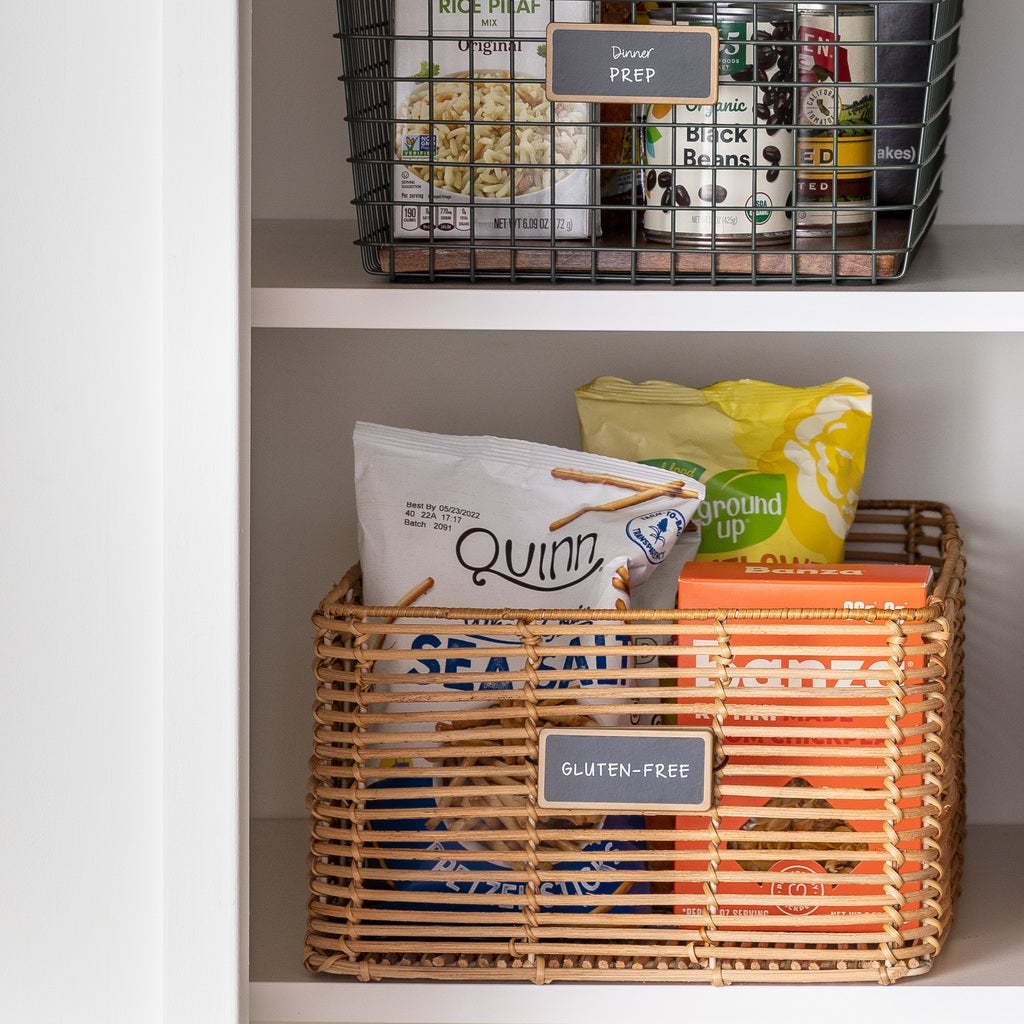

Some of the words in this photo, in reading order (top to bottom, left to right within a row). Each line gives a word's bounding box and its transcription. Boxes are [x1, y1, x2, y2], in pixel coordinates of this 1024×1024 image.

[481, 19, 498, 27] MIX
[457, 40, 523, 56] Original
[611, 46, 655, 61] Dinner
[610, 67, 656, 83] PREP
[686, 125, 748, 144] Black
[684, 148, 750, 167] Beans
[754, 200, 768, 208] SDA
[404, 207, 416, 218] 190
[494, 218, 508, 229] NET
[522, 218, 538, 229] 6.09
[539, 218, 549, 229] OZ
[404, 509, 415, 517] 40
[420, 511, 437, 520] 22A
[441, 513, 462, 524] 17:17
[406, 501, 424, 510] Best
[426, 504, 437, 512] By
[438, 504, 481, 520] 05/23/2022
[698, 492, 783, 526] ground
[404, 518, 427, 528] Batch
[433, 522, 452, 532] 2091
[717, 519, 746, 544] up
[455, 527, 604, 592] Quinn
[407, 634, 514, 692] SEA
[561, 762, 691, 778] GLUTEN-FREE
